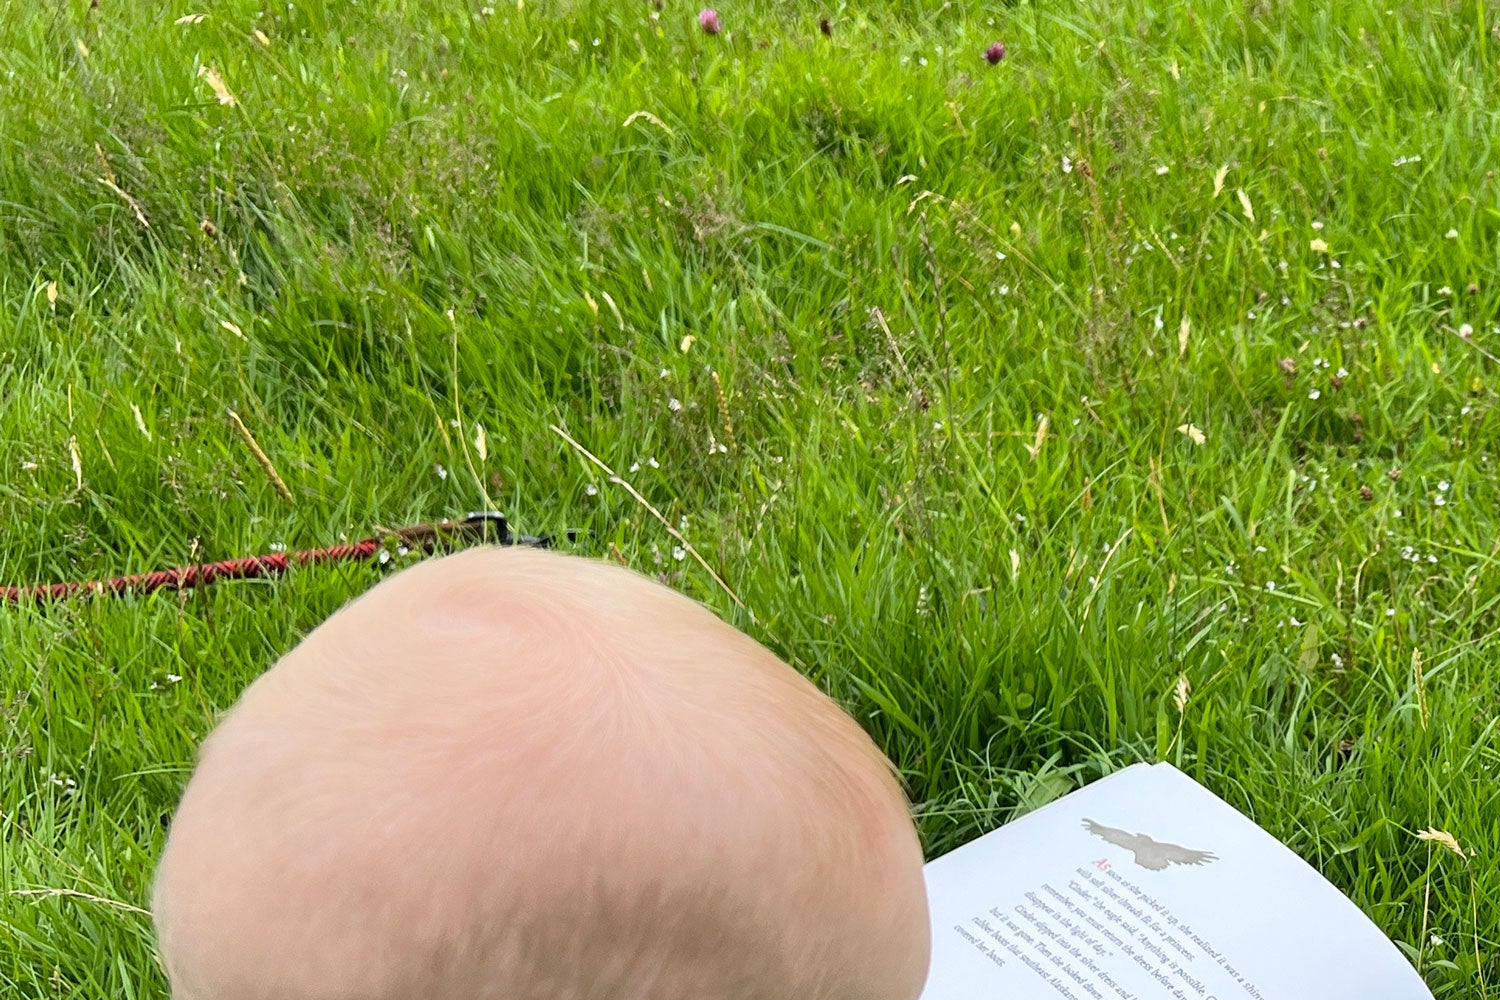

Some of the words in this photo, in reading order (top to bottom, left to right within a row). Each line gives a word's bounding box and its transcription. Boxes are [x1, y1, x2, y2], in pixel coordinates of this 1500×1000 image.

[1024, 891, 1055, 914] disappear
[1052, 912, 1062, 920] in
[1059, 918, 1072, 928] the
[1070, 925, 1088, 940] light
[1076, 867, 1092, 879] with
[1089, 878, 1105, 888] soft
[1101, 886, 1121, 900] silver
[1117, 898, 1143, 918] threads
[1140, 915, 1152, 925] fit
[1148, 922, 1162, 932] for
[1092, 901, 1106, 910] the
[1092, 859, 1111, 870] As
[1105, 870, 1122, 882] soon
[1128, 885, 1142, 896] she
[1137, 894, 1165, 912] picked
[1177, 925, 1192, 936] she
[1190, 935, 1222, 959] realized
[1217, 957, 1227, 965] it
[1224, 964, 1240, 978] was
[1104, 909, 1122, 923] eagle
[953, 925, 981, 944] covered
[976, 941, 989, 952] her
[971, 917, 994, 934] rubber
[991, 930, 1010, 947] boots
[1007, 944, 1023, 956] that
[1019, 955, 1051, 980] southeast
[989, 907, 1003, 918] but
[999, 915, 1009, 923] it
[1006, 921, 1020, 931] was
[1034, 941, 1052, 958] Then
[1049, 956, 1064, 967] she
[1062, 963, 1088, 984] looked
[1082, 983, 1103, 1000] down
[1014, 905, 1037, 923] Cinder
[1034, 921, 1061, 940] slipped
[1056, 937, 1071, 949] into
[1068, 947, 1082, 958] the
[1079, 957, 1101, 973] silver
[1097, 972, 1118, 988] dress
[1115, 987, 1134, 1000] and
[1070, 907, 1087, 918] you
[1085, 916, 1104, 931] must
[1101, 929, 1124, 947] return
[1121, 944, 1135, 956] the
[1133, 955, 1154, 971] dress
[1150, 968, 1174, 990] before
[1168, 961, 1178, 969] is
[1172, 968, 1205, 997] possible.
